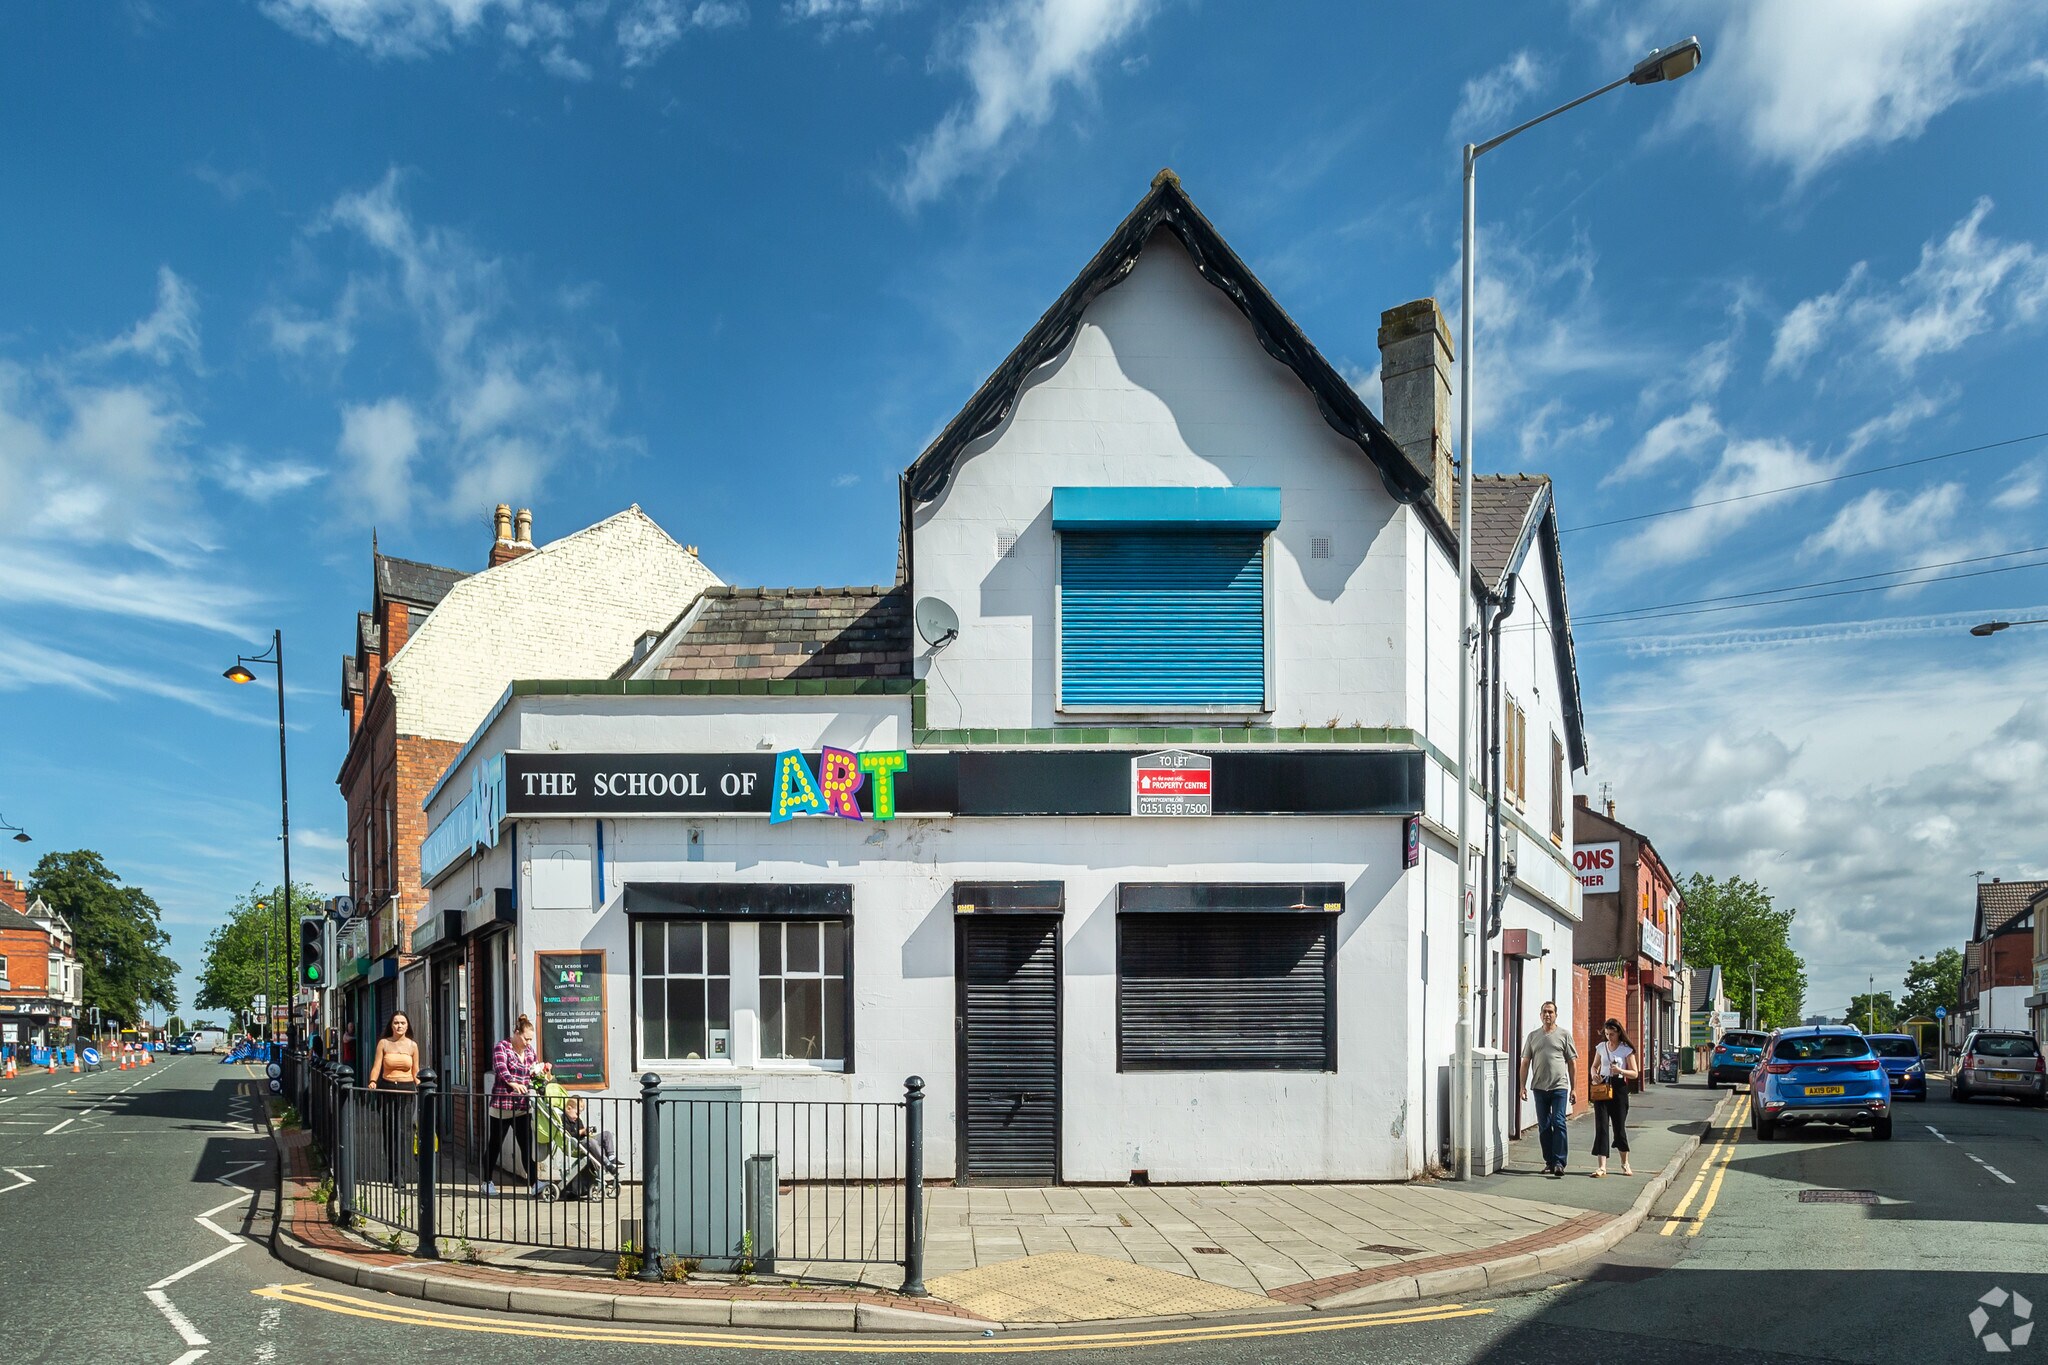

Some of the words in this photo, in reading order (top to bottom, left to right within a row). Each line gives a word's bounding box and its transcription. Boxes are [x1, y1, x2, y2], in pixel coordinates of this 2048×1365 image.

[1159, 756, 1172, 766] TO
[1174, 756, 1188, 767] LET
[521, 772, 577, 796] THE
[593, 772, 707, 796] SCHOOL
[720, 772, 757, 796] OF
[770, 745, 907, 824] ART
[434, 820, 457, 867] SCHOOL
[458, 806, 469, 843] OF
[471, 752, 502, 857] ART
[1140, 804, 1163, 814] 0151
[1166, 804, 1182, 814] 639
[1185, 804, 1207, 814] 7500
[560, 970, 583, 983] ART
